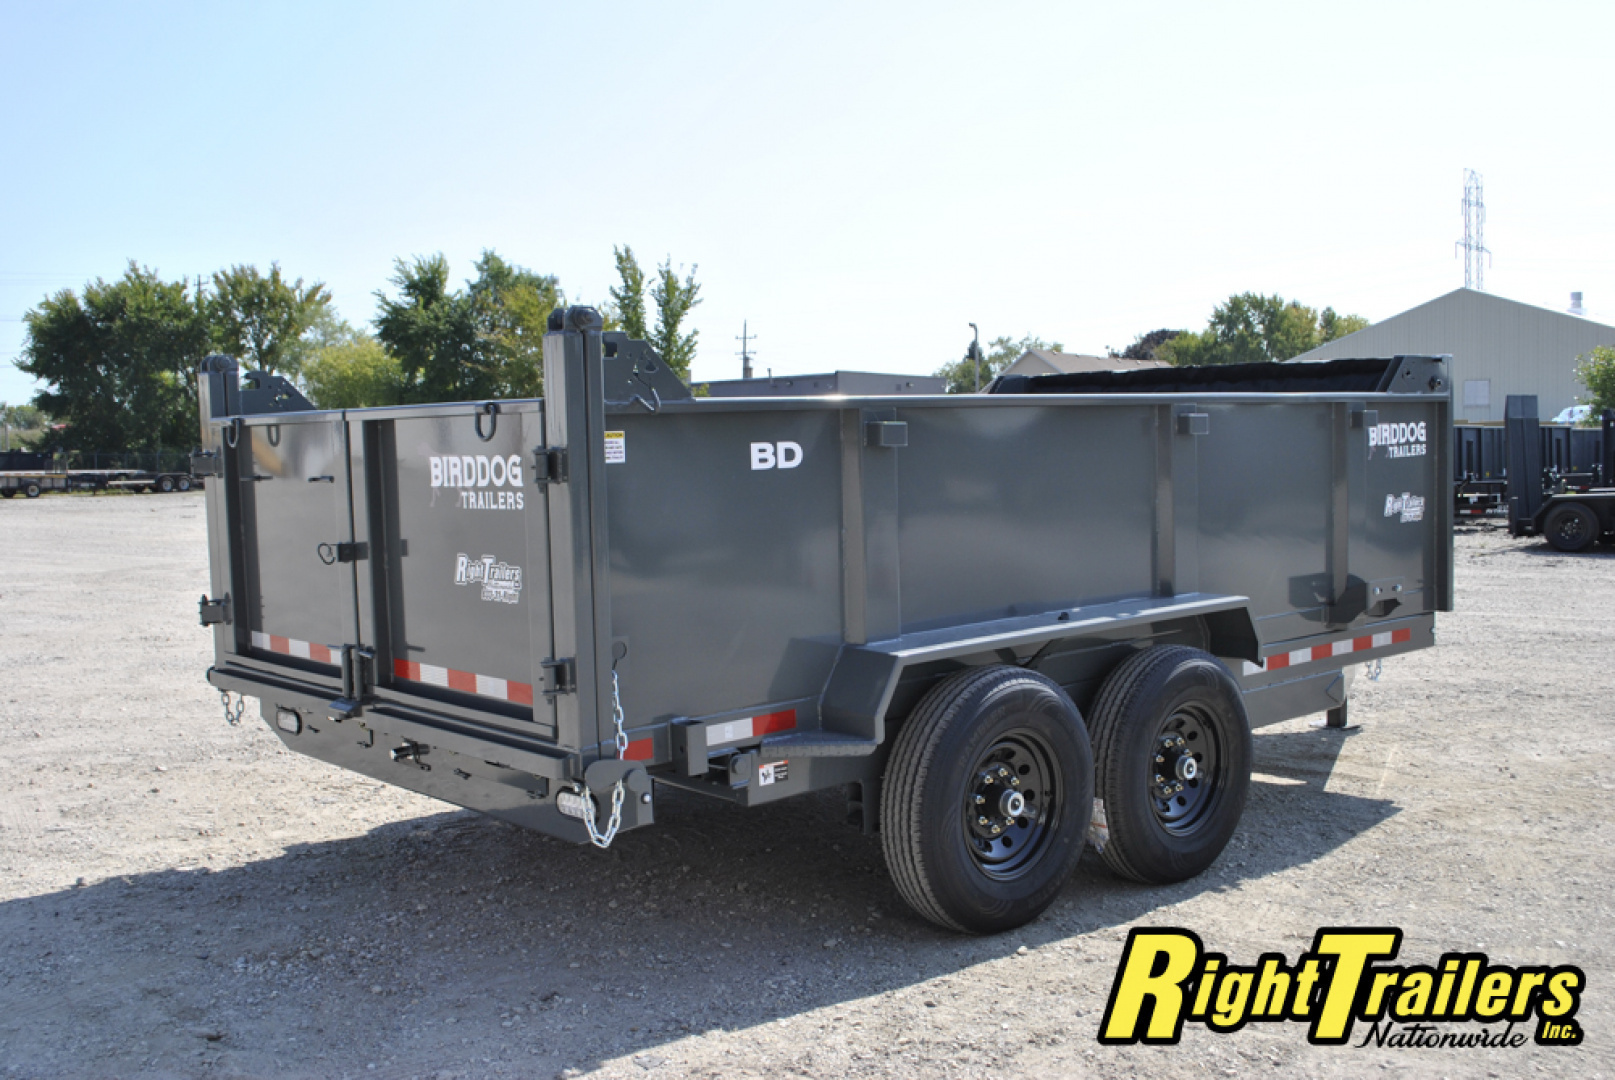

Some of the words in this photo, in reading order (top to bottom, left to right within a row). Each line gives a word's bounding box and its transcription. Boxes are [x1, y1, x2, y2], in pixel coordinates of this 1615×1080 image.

[1368, 421, 1427, 446] BIRDDOG
[750, 441, 803, 470] BD
[1388, 443, 1427, 459] TRAILERS
[429, 454, 524, 487] BIRDDOG
[461, 491, 524, 510] TRAILERS
